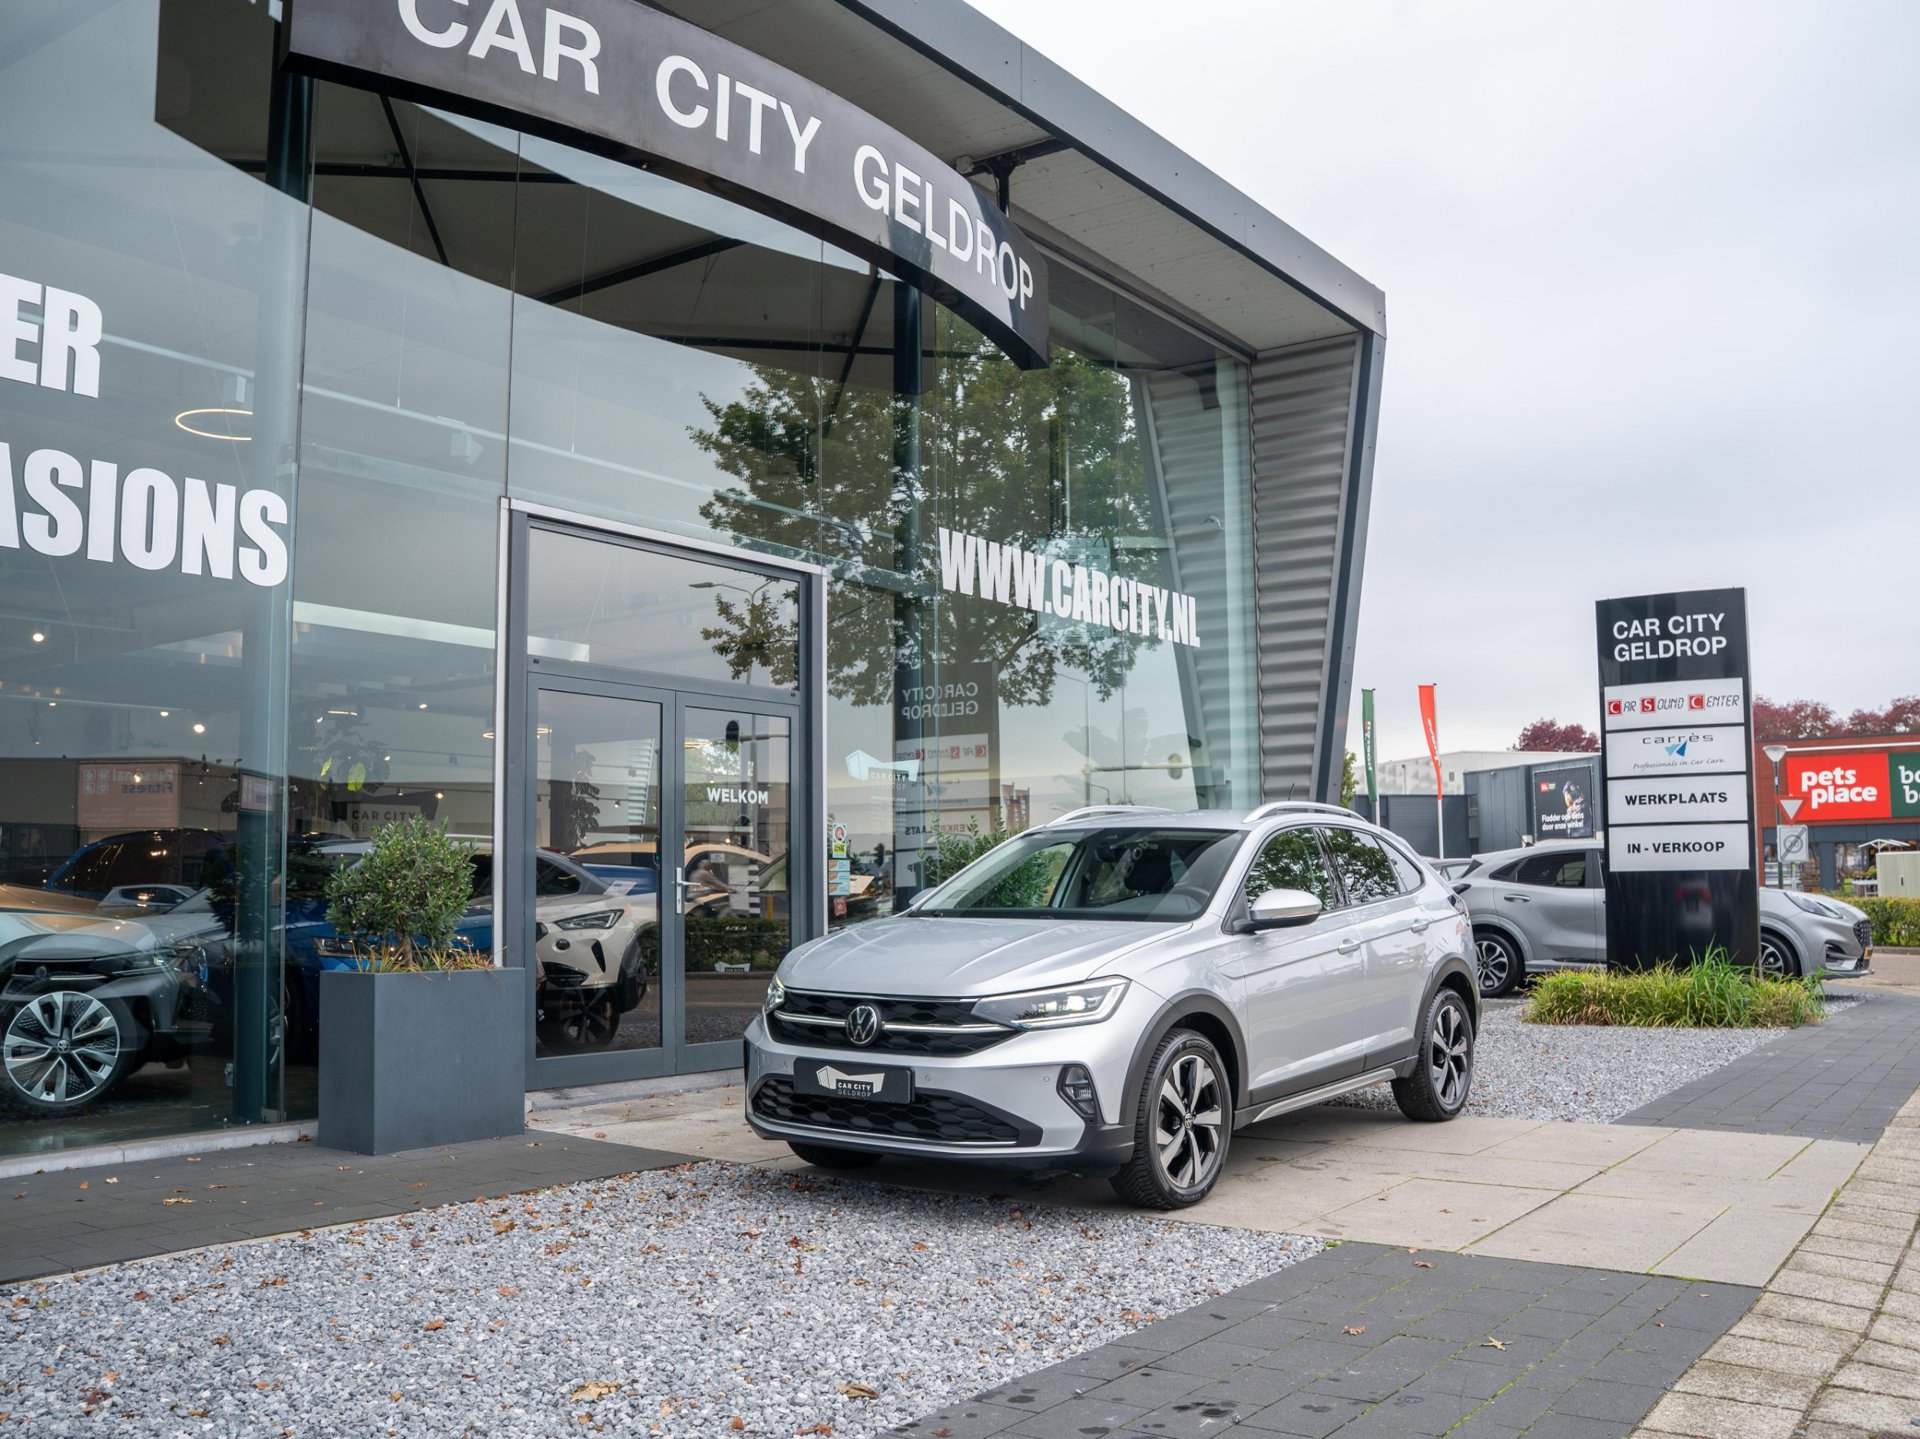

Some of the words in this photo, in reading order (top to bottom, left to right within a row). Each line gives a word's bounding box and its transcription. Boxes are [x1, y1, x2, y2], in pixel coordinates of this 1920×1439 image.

[398, 0, 601, 95] CAR
[655, 54, 822, 174] CITY
[853, 144, 1034, 310] GELDROP
[938, 527, 1200, 648] WWW.CARCITY.NL
[1613, 618, 1660, 639] CAR
[1668, 613, 1725, 634] CITY
[1614, 636, 1727, 662] GELDROP
[1642, 733, 1714, 745] carrès
[1801, 767, 1856, 792] pets
[707, 787, 768, 804] WELKOM
[1625, 792, 1728, 806] WERKPLAATS
[1811, 785, 1878, 809] place
[352, 810, 379, 820] CAR
[1627, 843, 1641, 854] IN
[1652, 841, 1725, 854] VERKOOP
[837, 1081, 852, 1090] CAR
[853, 1083, 872, 1091] CITY
[837, 1089, 872, 1098] GELDROP
